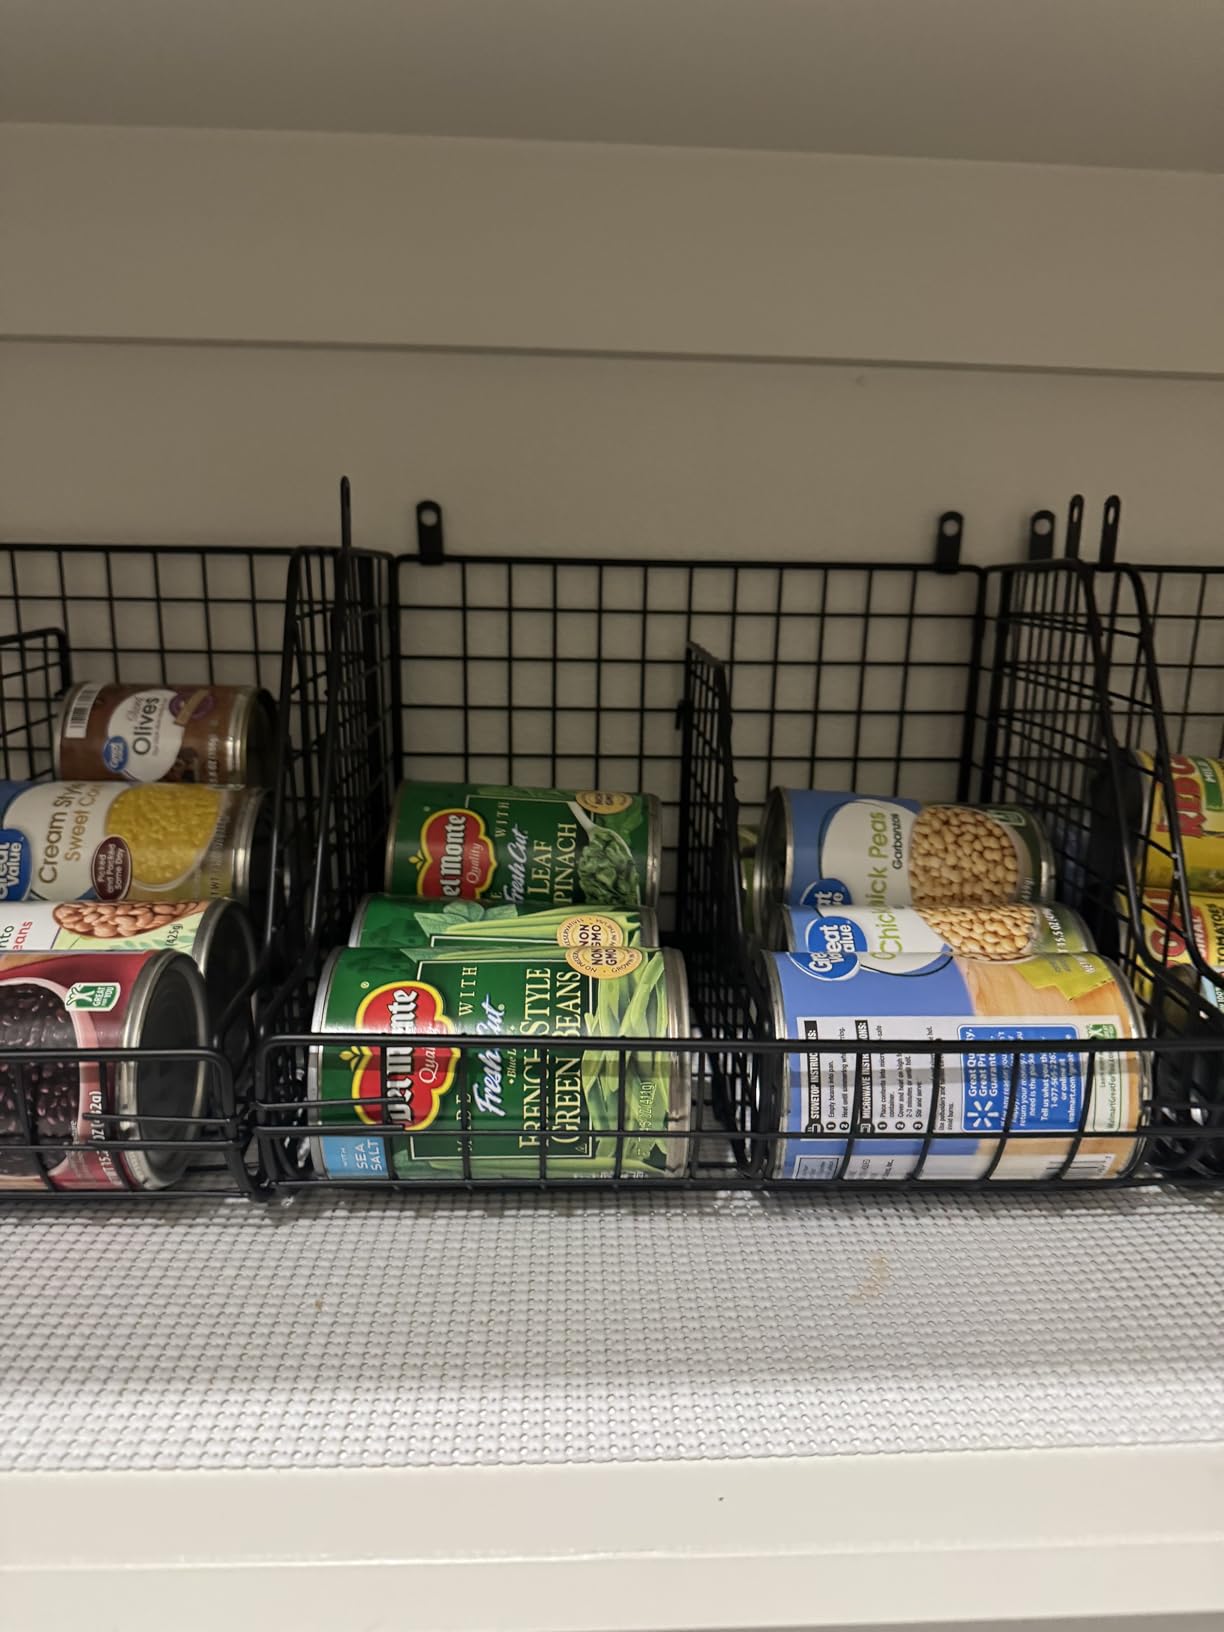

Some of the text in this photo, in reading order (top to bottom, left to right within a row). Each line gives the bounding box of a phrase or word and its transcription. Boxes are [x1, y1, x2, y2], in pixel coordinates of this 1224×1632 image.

[132, 697, 160, 756] Olives
[64, 810, 90, 861] Sweet
[494, 800, 511, 838] WITH
[866, 811, 890, 859] Peas
[38, 811, 68, 884] Cream
[439, 814, 467, 897] el Monte
[890, 812, 903, 871] Garbanzos
[6, 842, 22, 887] Value
[465, 842, 485, 885] Quality
[502, 823, 529, 903] Fresh Cut
[527, 839, 553, 895] LEAF
[552, 822, 578, 904] PINACH
[12, 921, 33, 951] eans
[578, 924, 590, 947] NON
[591, 924, 602, 947] GMO
[838, 924, 857, 954] alue
[590, 948, 604, 966] NON
[604, 948, 618, 966] GMO
[458, 966, 478, 1017] WITH
[519, 967, 552, 1037] STYLE
[386, 989, 418, 1076] Mnte
[472, 1047, 506, 1117] Fresh
[968, 1069, 978, 1097] Great
[978, 1069, 988, 1097] Great
[1021, 1087, 1029, 1104] your
[1041, 1079, 1049, 1098] what
[1059, 1069, 1067, 1091] online
[1060, 1091, 1067, 1101] or
[810, 1085, 821, 1120] STOVETOP
[828, 1101, 836, 1118] Empty
[861, 1076, 872, 1120] MICROWAVE
[1028, 1098, 1036, 1117] need
[1041, 1107, 1049, 1121] Tell
[1042, 1098, 1049, 1107] us
[354, 1143, 369, 1169] SEA
[366, 1138, 383, 1172] SALT
